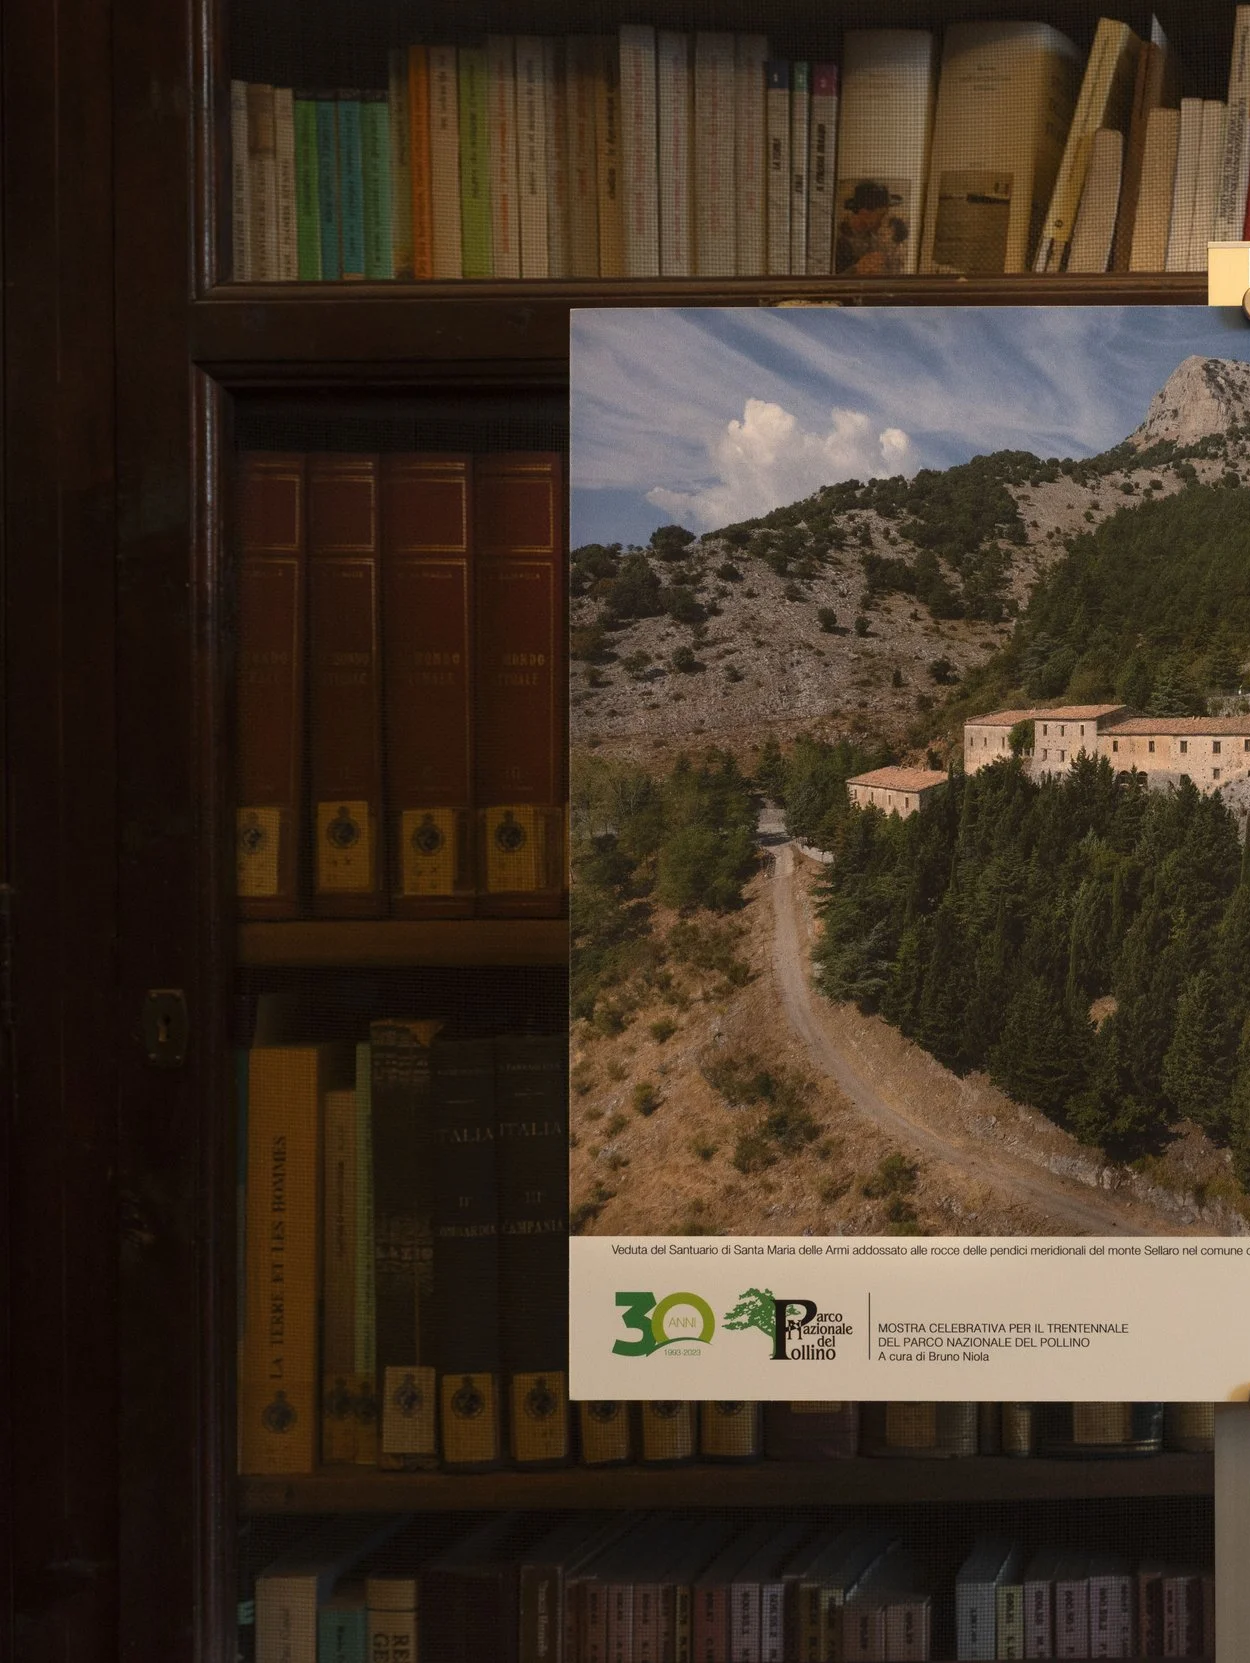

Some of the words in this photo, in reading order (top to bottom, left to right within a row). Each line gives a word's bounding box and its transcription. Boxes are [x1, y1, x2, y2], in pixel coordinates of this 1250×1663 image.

[500, 1120, 564, 1139] ITALIA
[272, 1134, 288, 1213] HOMMES
[437, 1220, 498, 1238] OMBARDIA
[501, 1217, 565, 1236] CAMPANIA
[272, 1221, 286, 1254] LES
[611, 1244, 649, 1256] Veduta
[650, 1244, 667, 1256] del
[668, 1244, 719, 1256] Santuario
[720, 1244, 732, 1256] di
[733, 1244, 765, 1256] Santa
[766, 1244, 796, 1256] Maria
[798, 1244, 824, 1256] delle
[824, 1244, 850, 1256] Armi
[852, 1244, 908, 1256] addossato
[909, 1245, 928, 1256] alle
[930, 1247, 961, 1256] rocce
[962, 1244, 988, 1256] delle
[989, 1244, 1028, 1258] pendici
[1030, 1244, 1087, 1256] meridionali
[1088, 1245, 1105, 1256] del
[1107, 1245, 1142, 1256] monte
[1143, 1244, 1180, 1256] Sellaro
[1182, 1245, 1198, 1256] nel
[1200, 1247, 1244, 1256] comune
[271, 1261, 286, 1287] ET
[270, 1294, 286, 1349] TERRE
[612, 1291, 716, 1357] 30
[668, 1316, 697, 1329] ANNI
[878, 1322, 927, 1334] MOSTRA
[928, 1322, 1007, 1334] CELEBRATIVA
[1008, 1323, 1032, 1334] PER
[1034, 1323, 1045, 1334] IL
[1046, 1323, 1129, 1334] TRENTENNALE
[816, 1335, 837, 1349] del
[878, 1336, 901, 1348] DEL
[903, 1336, 944, 1348] PARCO
[946, 1336, 1012, 1348] NAZIONALE
[1014, 1337, 1038, 1348] DEL
[1040, 1337, 1091, 1348] POLLINO
[663, 1347, 702, 1357] 1993-2023
[877, 1351, 887, 1361] A
[888, 1353, 913, 1362] cura
[915, 1351, 926, 1362] di
[928, 1351, 960, 1362] Bruno
[962, 1351, 990, 1362] Niola
[269, 1356, 284, 1380] LA
